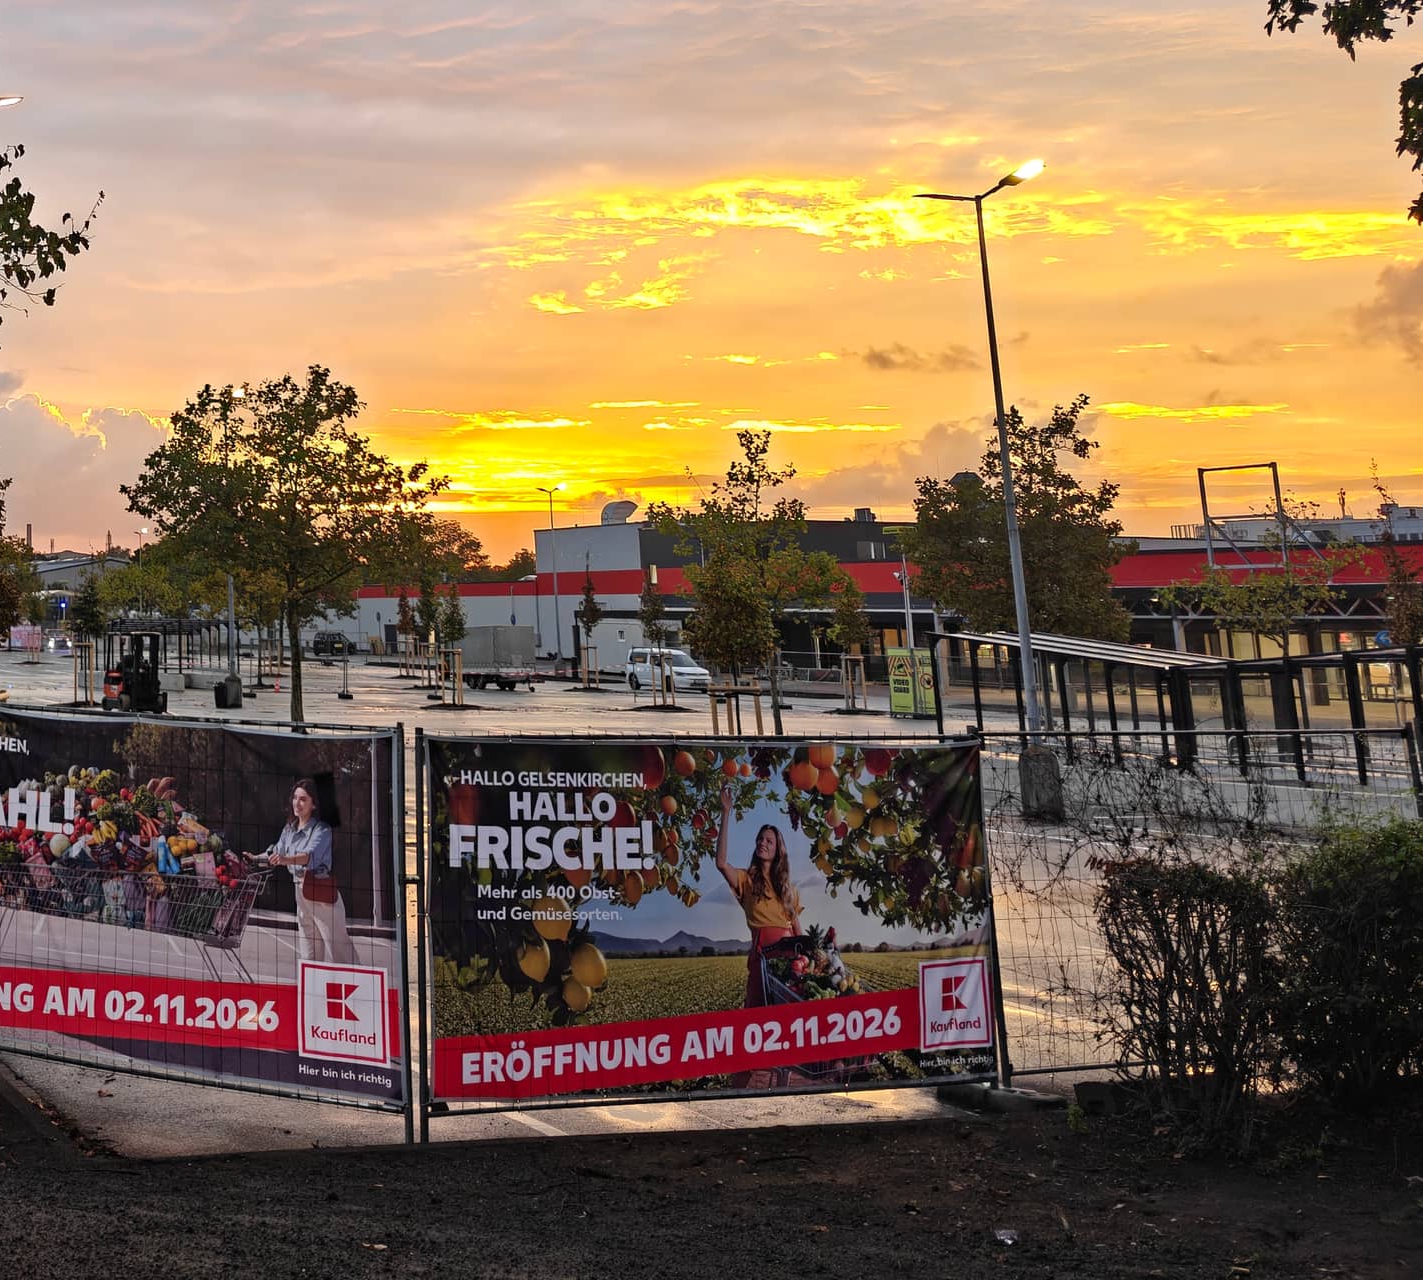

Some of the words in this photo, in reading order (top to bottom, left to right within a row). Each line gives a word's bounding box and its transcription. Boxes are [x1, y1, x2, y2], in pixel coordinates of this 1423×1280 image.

[461, 769, 515, 786] HALLO
[518, 771, 647, 790] GELSENKIRCHEN,
[509, 791, 617, 822] HALLO
[449, 819, 657, 871] FRISCHE!
[477, 884, 518, 900] Mehr
[521, 884, 543, 900] als
[546, 885, 576, 900] 400
[580, 886, 621, 900] Obst-
[477, 906, 507, 921] und
[510, 906, 623, 922] Gemüsesorten.
[42, 985, 96, 1019] AM
[104, 989, 280, 1032] 02.11.2026
[311, 1024, 377, 1046] Kaufland
[930, 1016, 981, 1033] Kaufland
[462, 1033, 672, 1085] ERÖFFNUNG
[680, 1025, 734, 1063] AM
[743, 1006, 902, 1054] 02.11.2026
[298, 1063, 320, 1076] Hier
[322, 1067, 339, 1079] bin
[341, 1069, 356, 1081] ich
[358, 1072, 392, 1089] richtig
